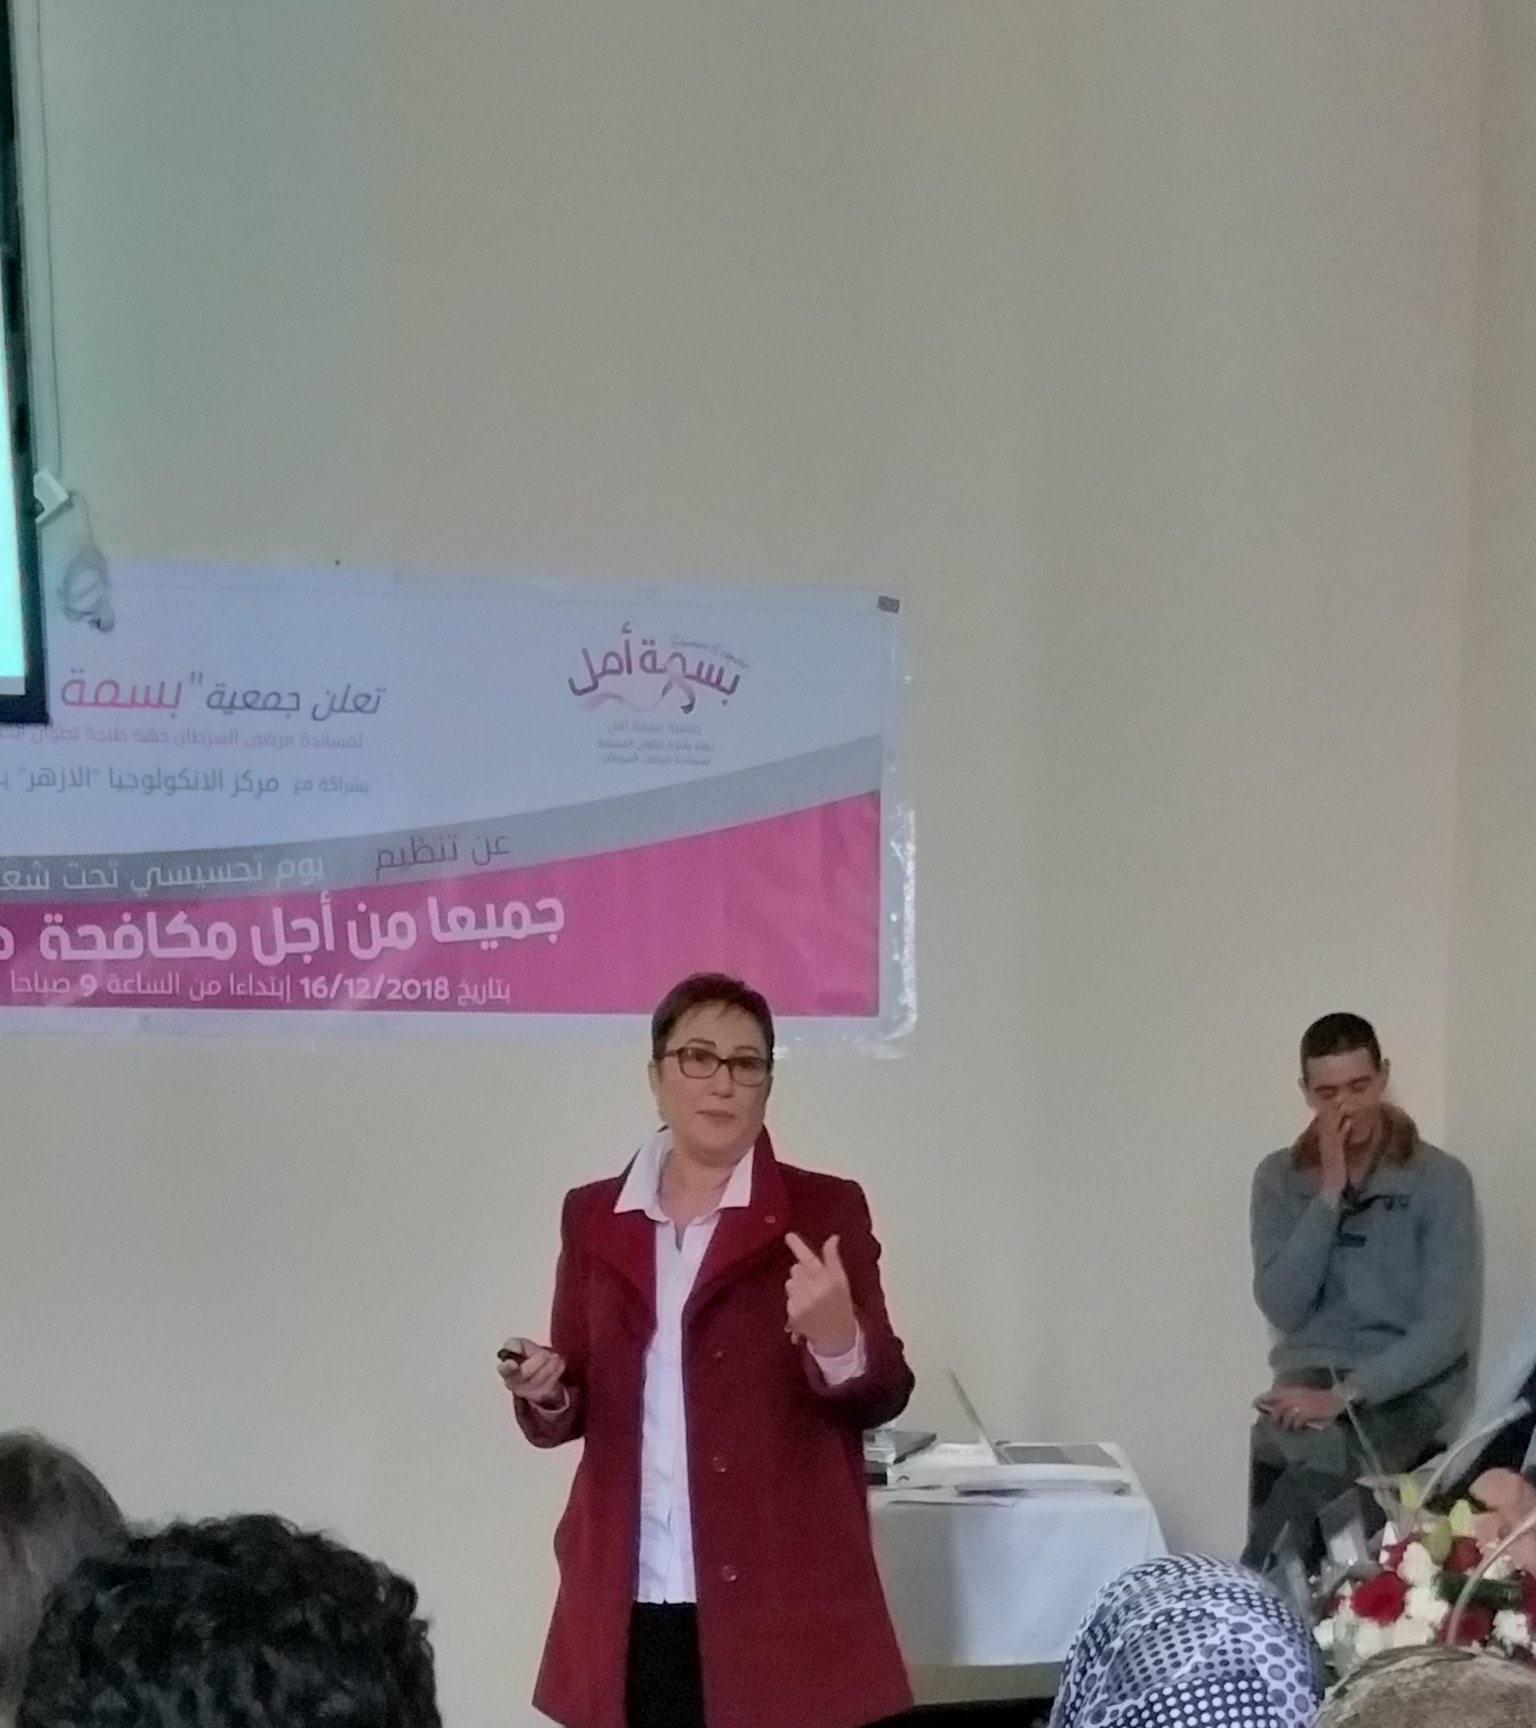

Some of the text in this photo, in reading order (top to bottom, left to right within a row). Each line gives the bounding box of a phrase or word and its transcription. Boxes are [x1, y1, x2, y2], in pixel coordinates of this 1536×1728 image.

[567, 620, 633, 697] أمل
[638, 637, 741, 710] بسمة
[206, 682, 302, 719] جمعية
[311, 683, 386, 722] تعلن
[231, 768, 280, 799] مركز
[293, 779, 314, 796] مع
[375, 834, 459, 881] تنظيم
[471, 834, 511, 867] عن
[63, 861, 120, 890] تحت
[130, 852, 264, 898] تحسيسي
[276, 857, 325, 889] يوم
[39, 910, 238, 961] مكافحة
[250, 890, 336, 966] أجل
[347, 902, 418, 960] من
[427, 896, 565, 951] جميعا
[11, 969, 71, 997] صباحا
[80, 973, 98, 997] 9
[106, 971, 180, 996] الساعة
[189, 978, 222, 1001] من
[299, 973, 450, 1000] 16/12/2018
[457, 977, 511, 1006] بتاريخ
